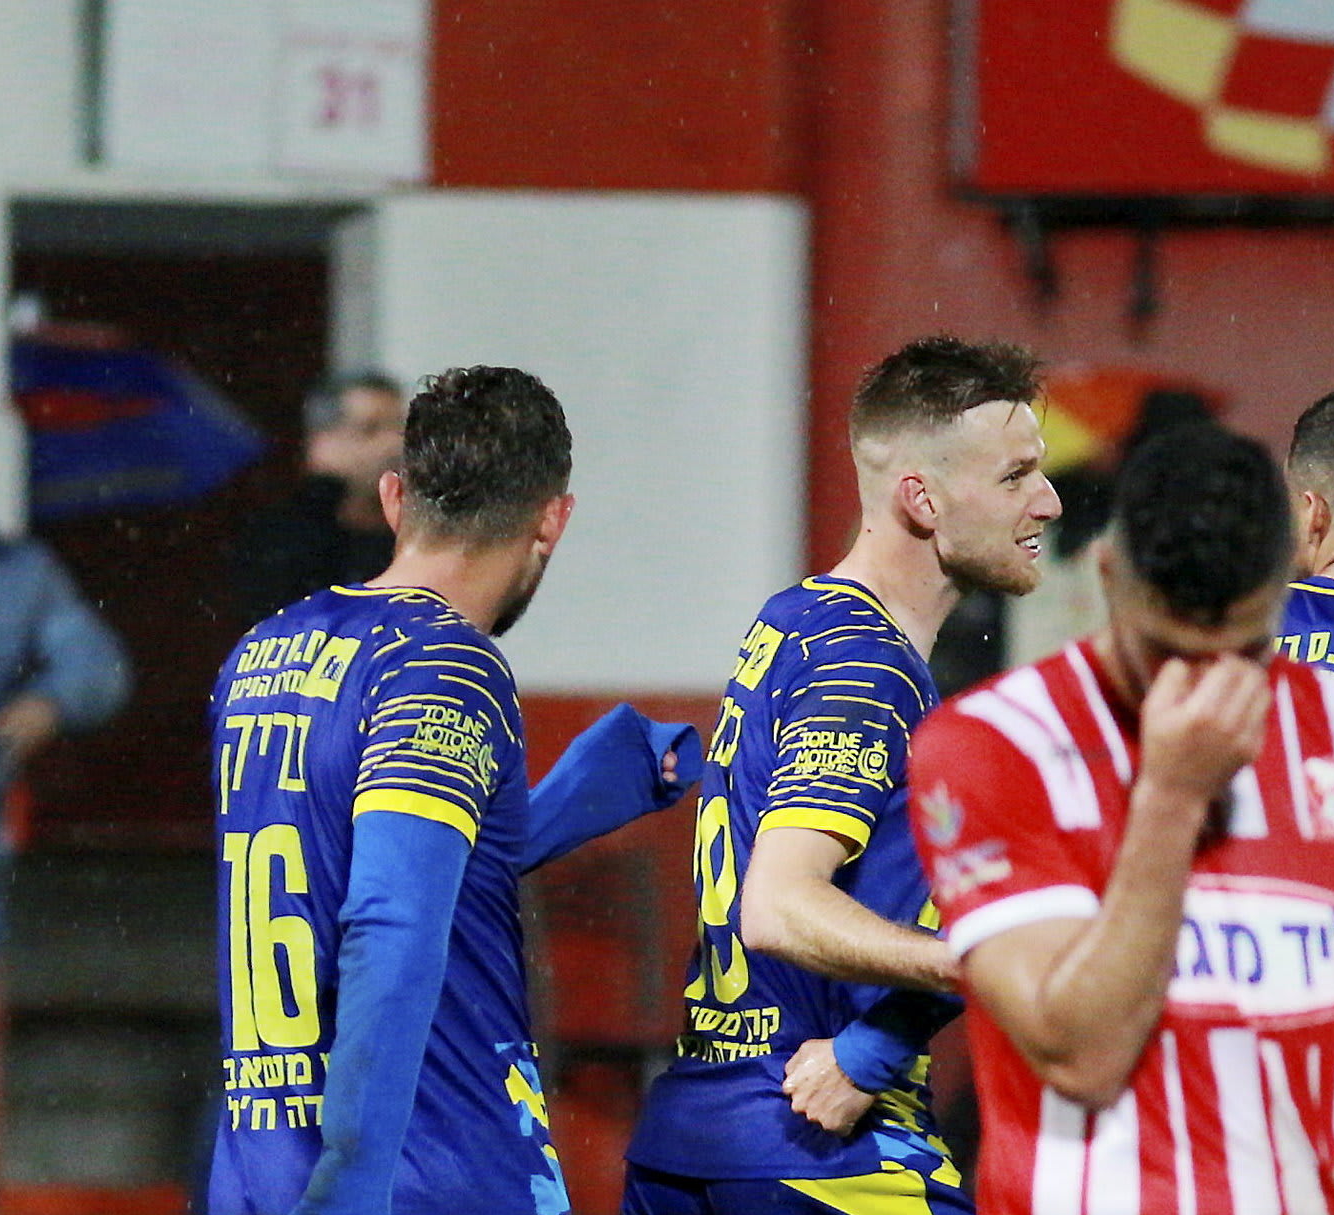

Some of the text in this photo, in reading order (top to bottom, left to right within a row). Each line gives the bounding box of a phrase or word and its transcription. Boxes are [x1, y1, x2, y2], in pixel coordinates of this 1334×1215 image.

[799, 731, 863, 750] TOPLINE
[794, 748, 860, 768] MOTORS
[222, 824, 321, 1052] 16
